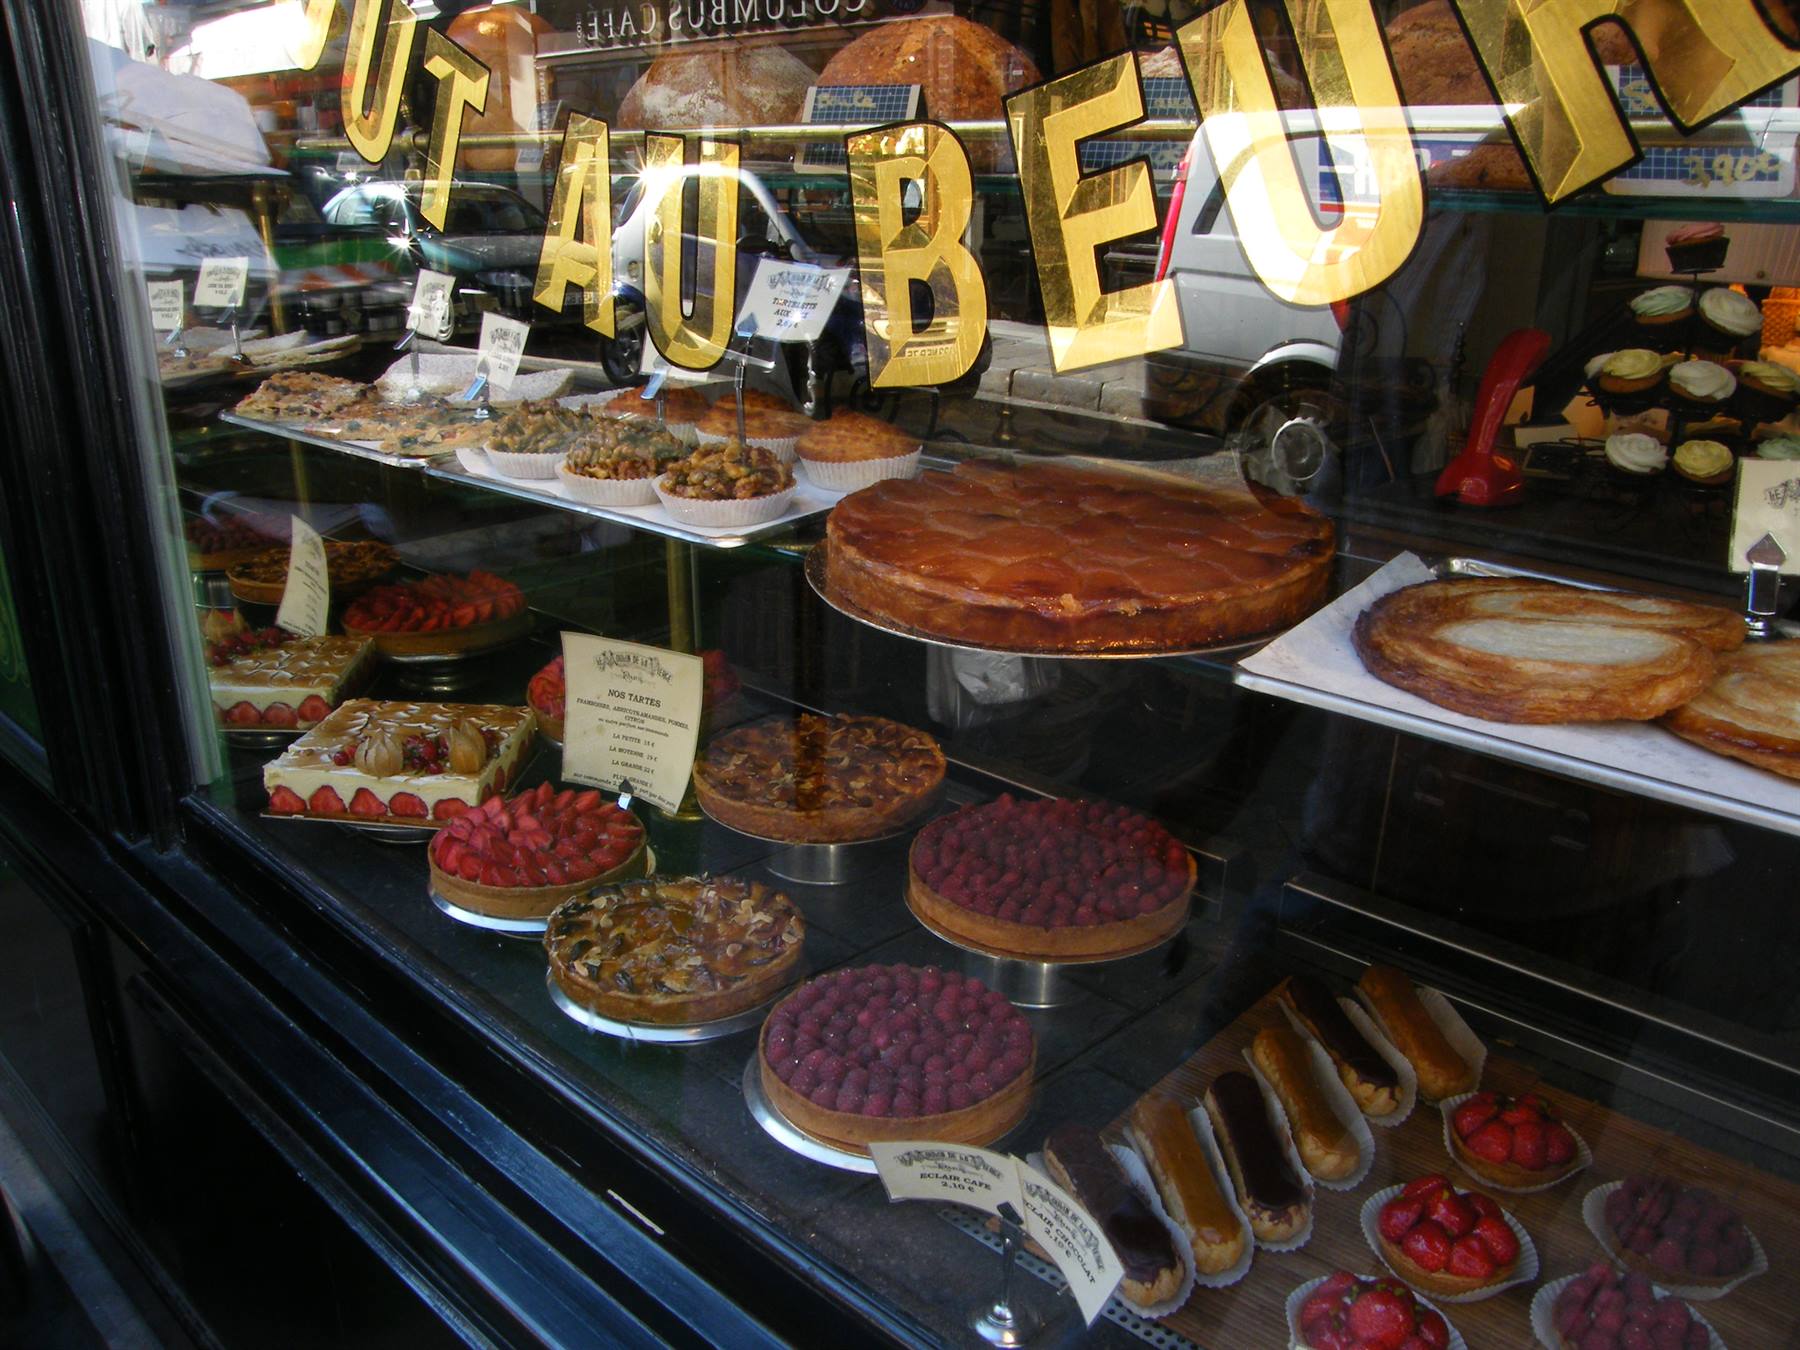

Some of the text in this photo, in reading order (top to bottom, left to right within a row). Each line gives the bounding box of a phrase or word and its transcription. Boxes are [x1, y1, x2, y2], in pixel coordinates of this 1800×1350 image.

[533, 111, 742, 369] AU
[607, 689, 662, 708] NOS TARTES
[621, 735, 642, 745] PETITE
[620, 761, 643, 772] GRANDE
[920, 1173, 992, 1190] ECLAIR CAFE
[1024, 1200, 1097, 1284] CLAIR CHOCOLAT
